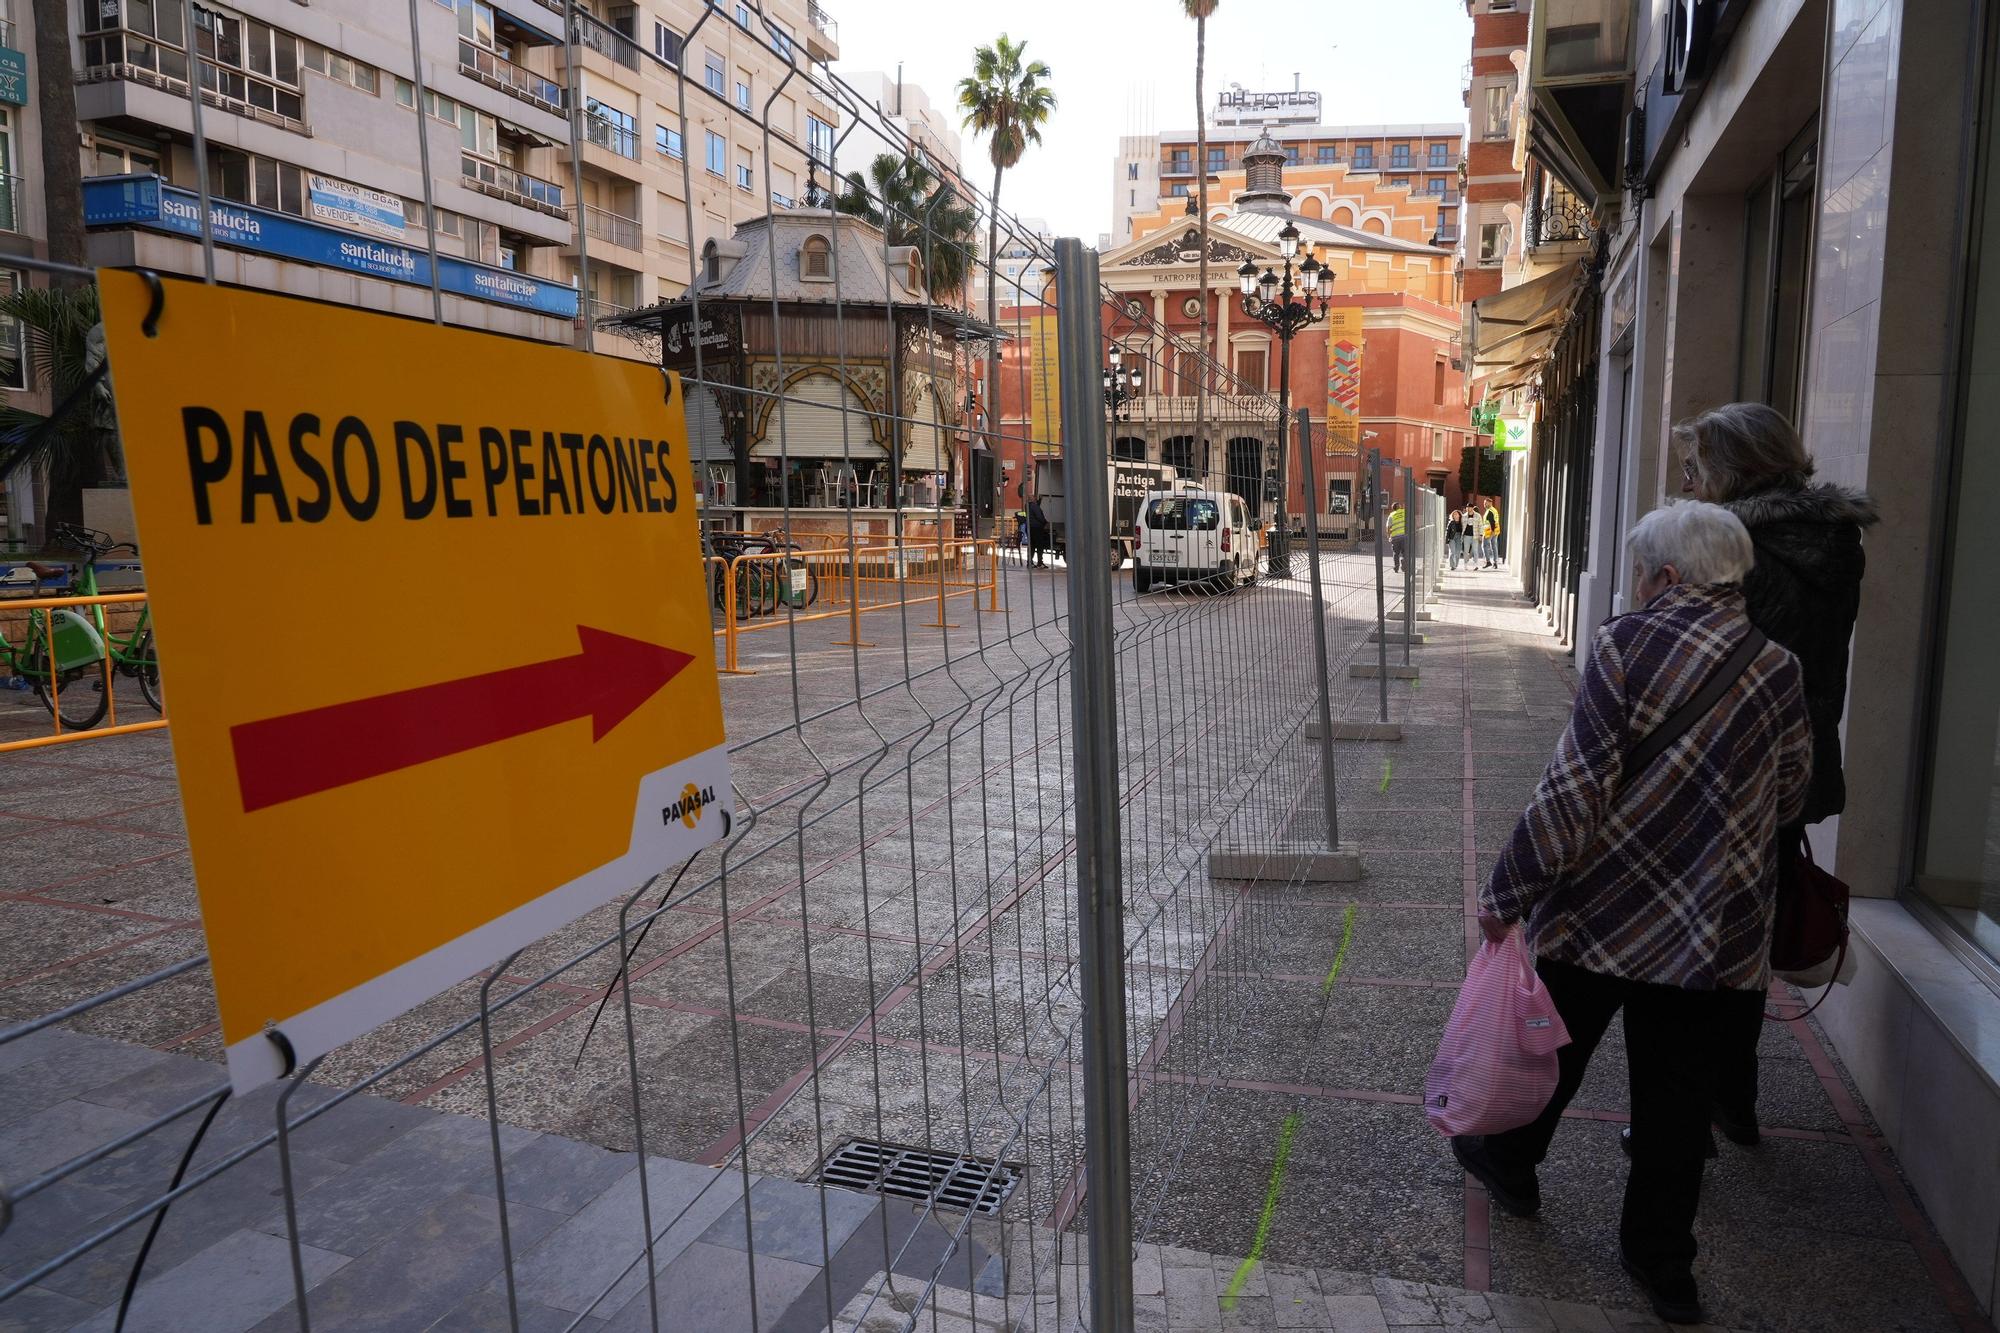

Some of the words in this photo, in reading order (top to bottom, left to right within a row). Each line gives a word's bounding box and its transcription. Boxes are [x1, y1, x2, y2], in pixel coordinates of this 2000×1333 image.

[1253, 91, 1317, 106] HOTELS
[325, 180, 360, 195] NUEVO
[363, 190, 400, 208] HOGAR
[315, 205, 326, 216] SE
[327, 208, 354, 222] VENDE
[1153, 273, 1185, 283] TEATRO
[1185, 271, 1230, 281] PRICIPAL
[181, 406, 381, 525] PASO
[394, 420, 473, 520] DE
[479, 426, 678, 517] PEATONES
[662, 785, 716, 826] PAVASAL
